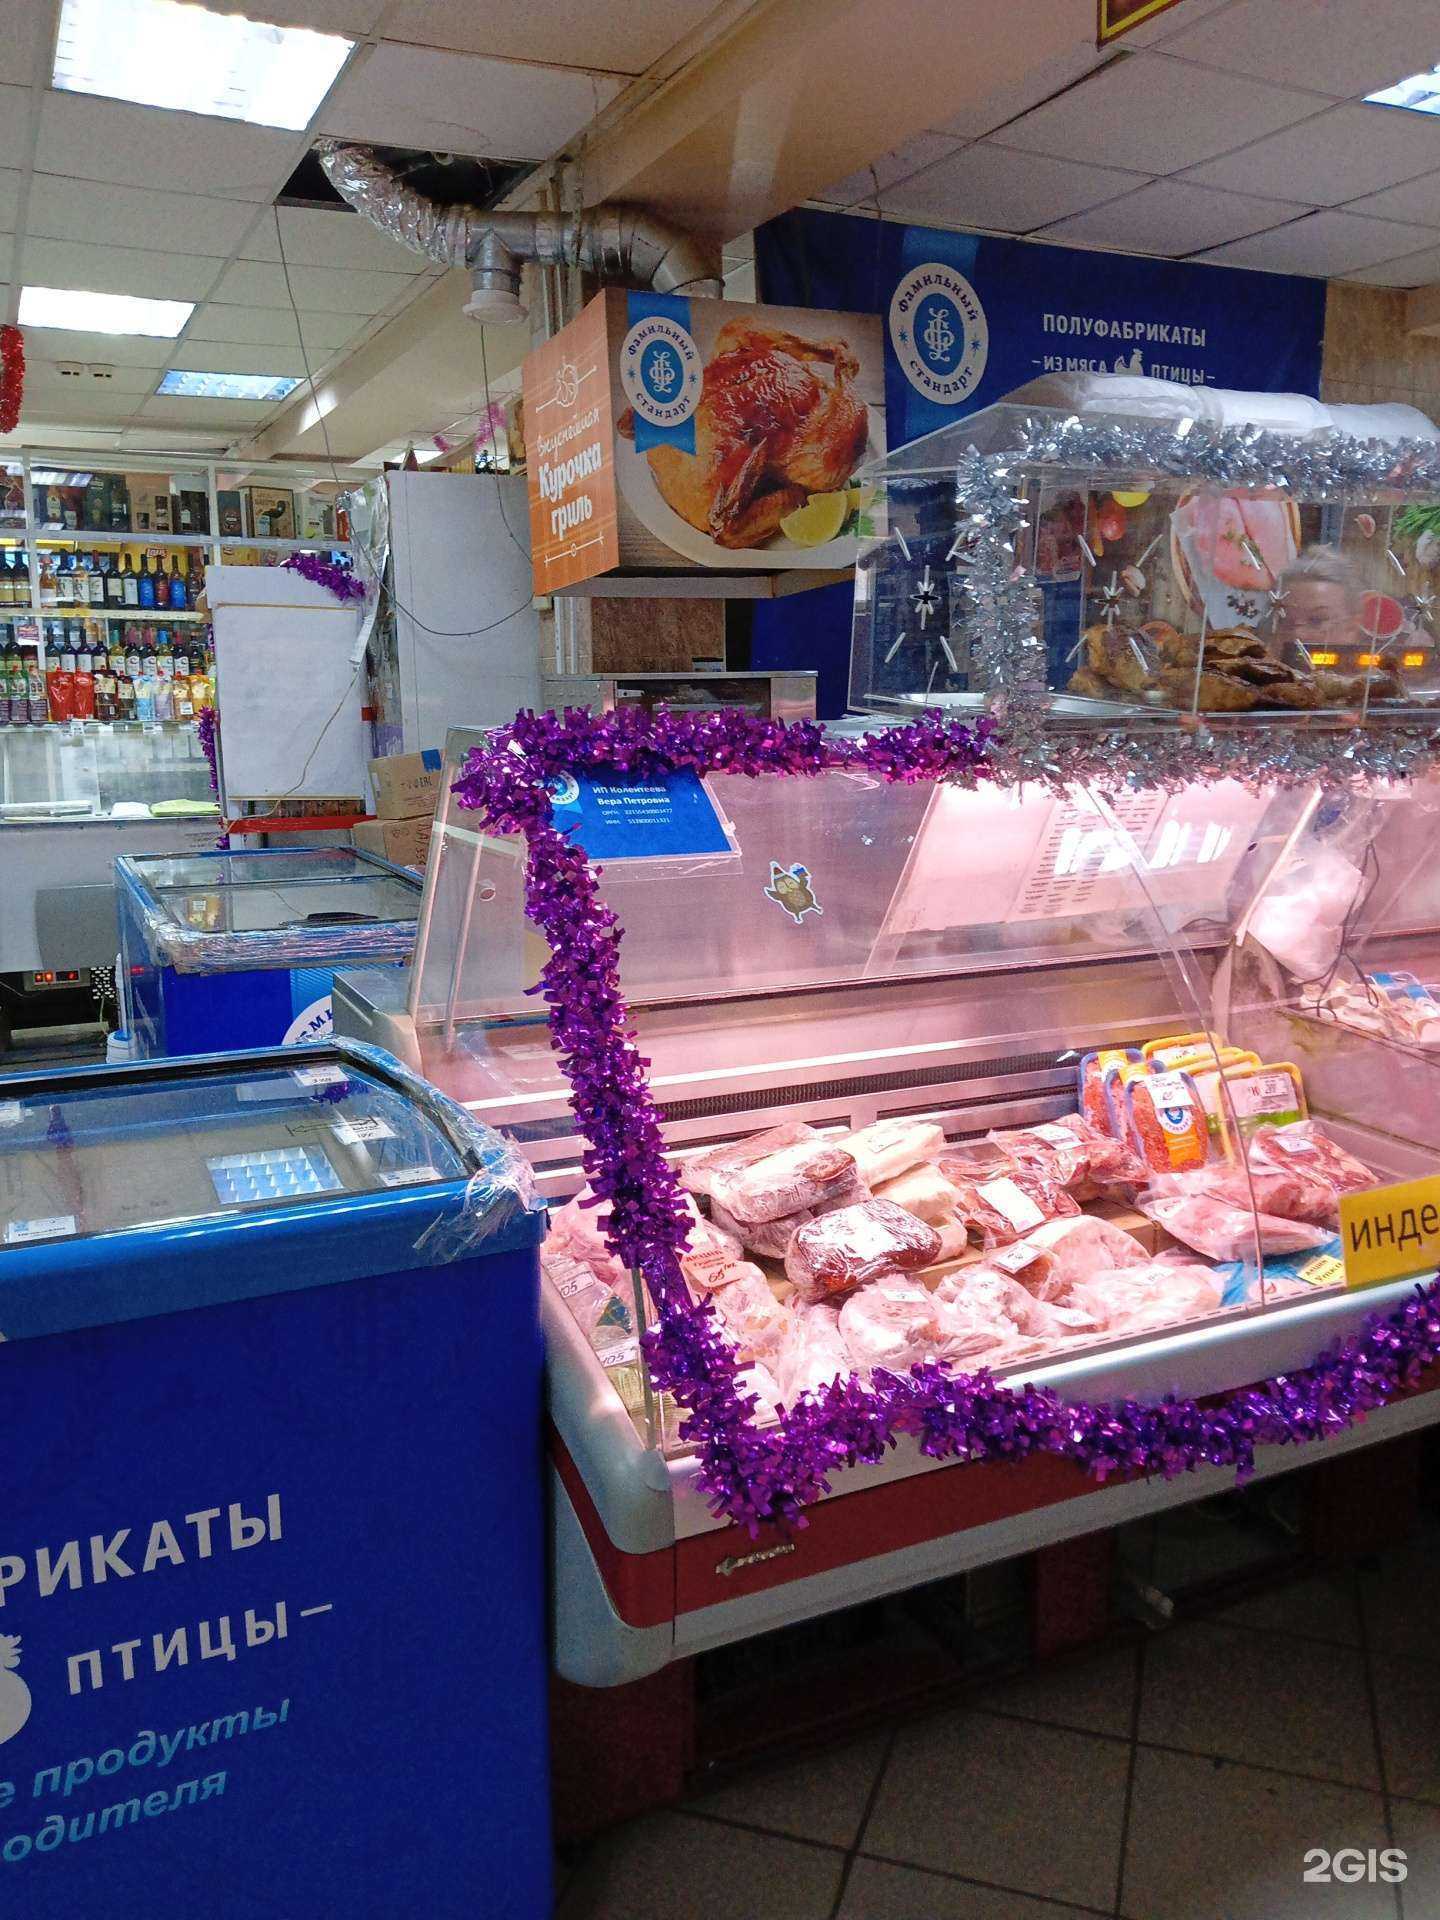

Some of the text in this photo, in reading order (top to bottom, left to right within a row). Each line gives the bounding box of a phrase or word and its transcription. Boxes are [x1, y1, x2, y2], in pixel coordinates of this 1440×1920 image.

[1042, 313, 1207, 347] ПОЛУФАБРИКАТЫ
[1043, 355, 1063, 372] ИЗ
[1151, 363, 1204, 386] ПТИЦЫ
[538, 441, 602, 503] Курочка
[550, 494, 593, 541] гриль
[592, 786, 608, 794] ИП
[597, 797, 671, 806] Вера Петровна
[66, 1600, 289, 1696] ПТИЦЫ
[32, 1698, 291, 1797] продукты
